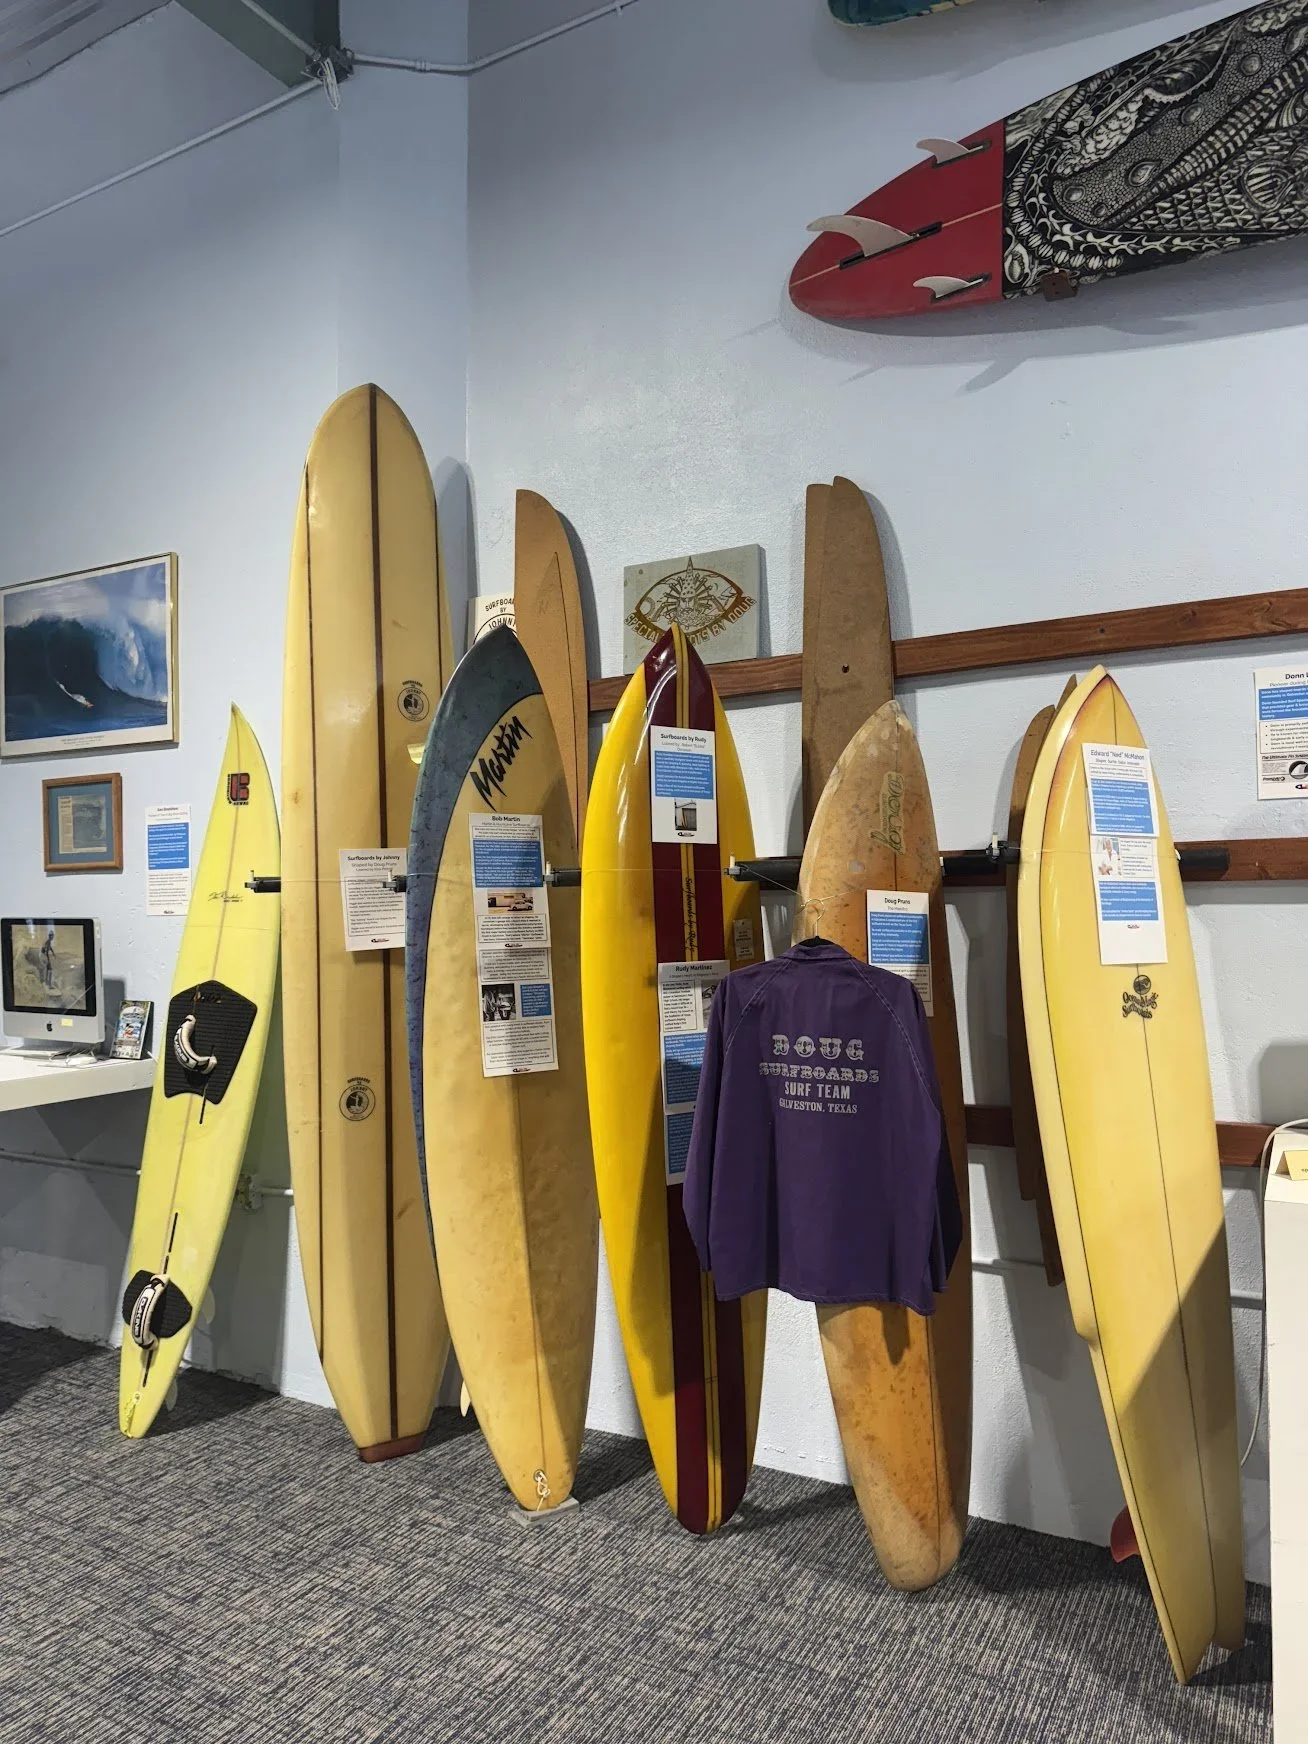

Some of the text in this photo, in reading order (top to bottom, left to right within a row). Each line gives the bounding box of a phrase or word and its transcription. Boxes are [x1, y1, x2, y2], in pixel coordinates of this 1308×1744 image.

[624, 611, 661, 645] SPECIAL
[711, 620, 727, 637] BY
[728, 596, 758, 624] DOUG
[660, 733, 687, 742] Surfboards
[694, 736, 707, 744] Rudy
[470, 715, 533, 812] Martin
[1090, 749, 1110, 757] Edward
[1124, 752, 1145, 760] McMahon
[884, 897, 897, 905] Doug
[772, 1034, 864, 1061] DOUG
[759, 1062, 880, 1083] SURFBOARDS
[784, 1081, 850, 1100] SURF TEAM
[827, 1102, 858, 1114] TEXAS
